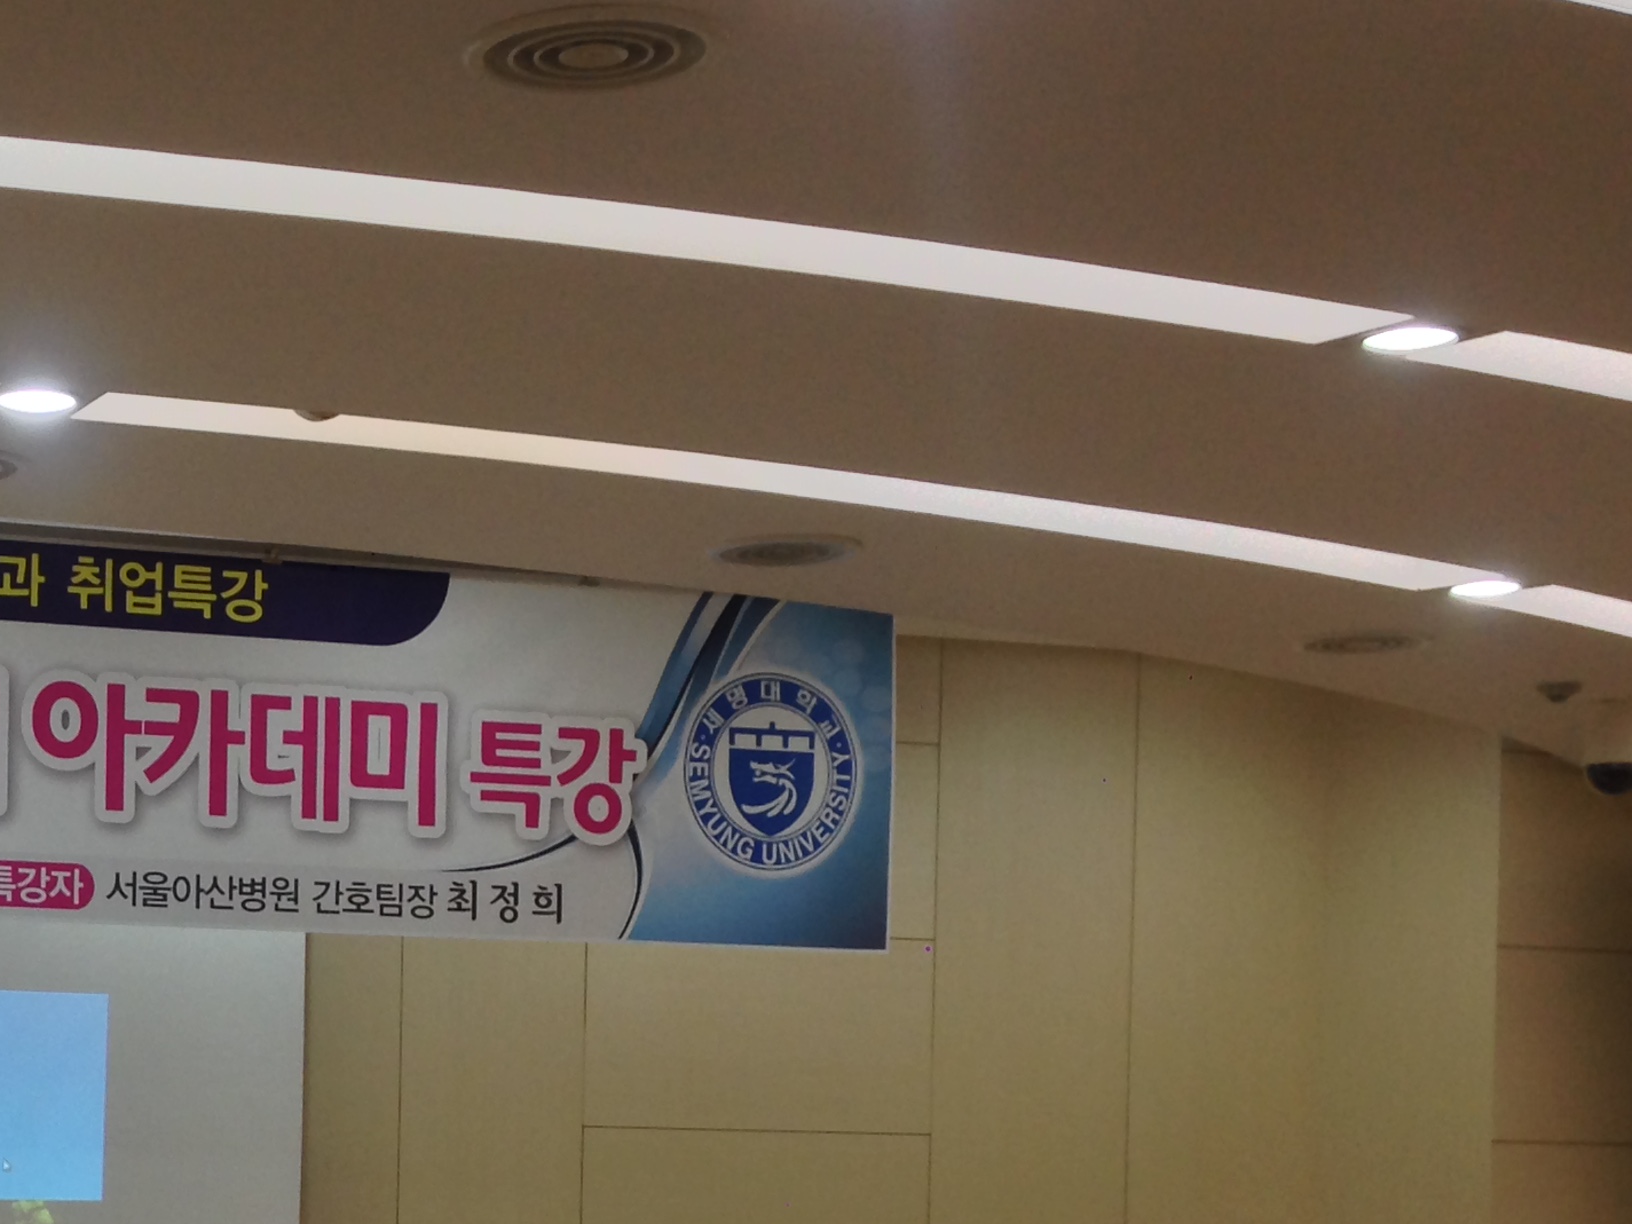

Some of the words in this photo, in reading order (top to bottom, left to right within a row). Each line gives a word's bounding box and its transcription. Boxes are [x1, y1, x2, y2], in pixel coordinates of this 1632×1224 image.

[66, 555, 269, 624] 취업특강
[30, 680, 438, 828] 아카데미
[469, 720, 638, 836] 특강
[689, 742, 756, 862] SEMYUNG
[762, 750, 852, 866] UNIVERSITY
[105, 870, 300, 914] 서울아산병원
[311, 880, 439, 919] 간호팀장
